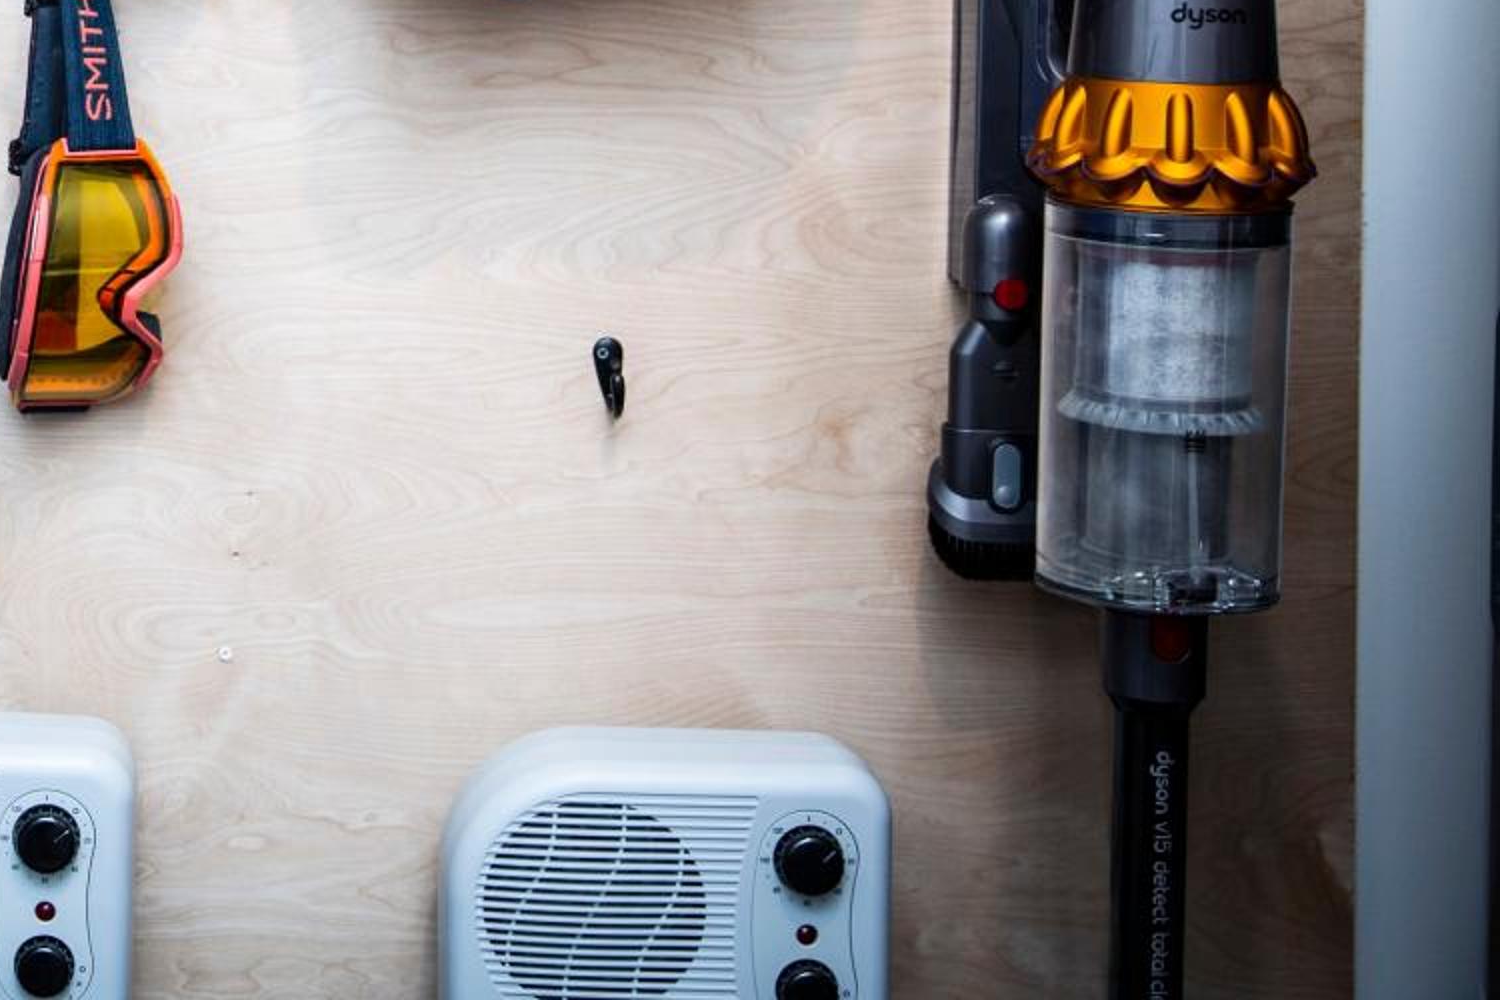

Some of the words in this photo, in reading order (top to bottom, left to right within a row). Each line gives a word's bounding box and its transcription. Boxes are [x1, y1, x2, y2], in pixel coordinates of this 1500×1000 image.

[1170, 1, 1248, 30] dyson
[1150, 750, 1175, 815] dyson
[1153, 820, 1173, 853] v15
[1152, 860, 1172, 925] detect
[1150, 932, 1171, 978] total
